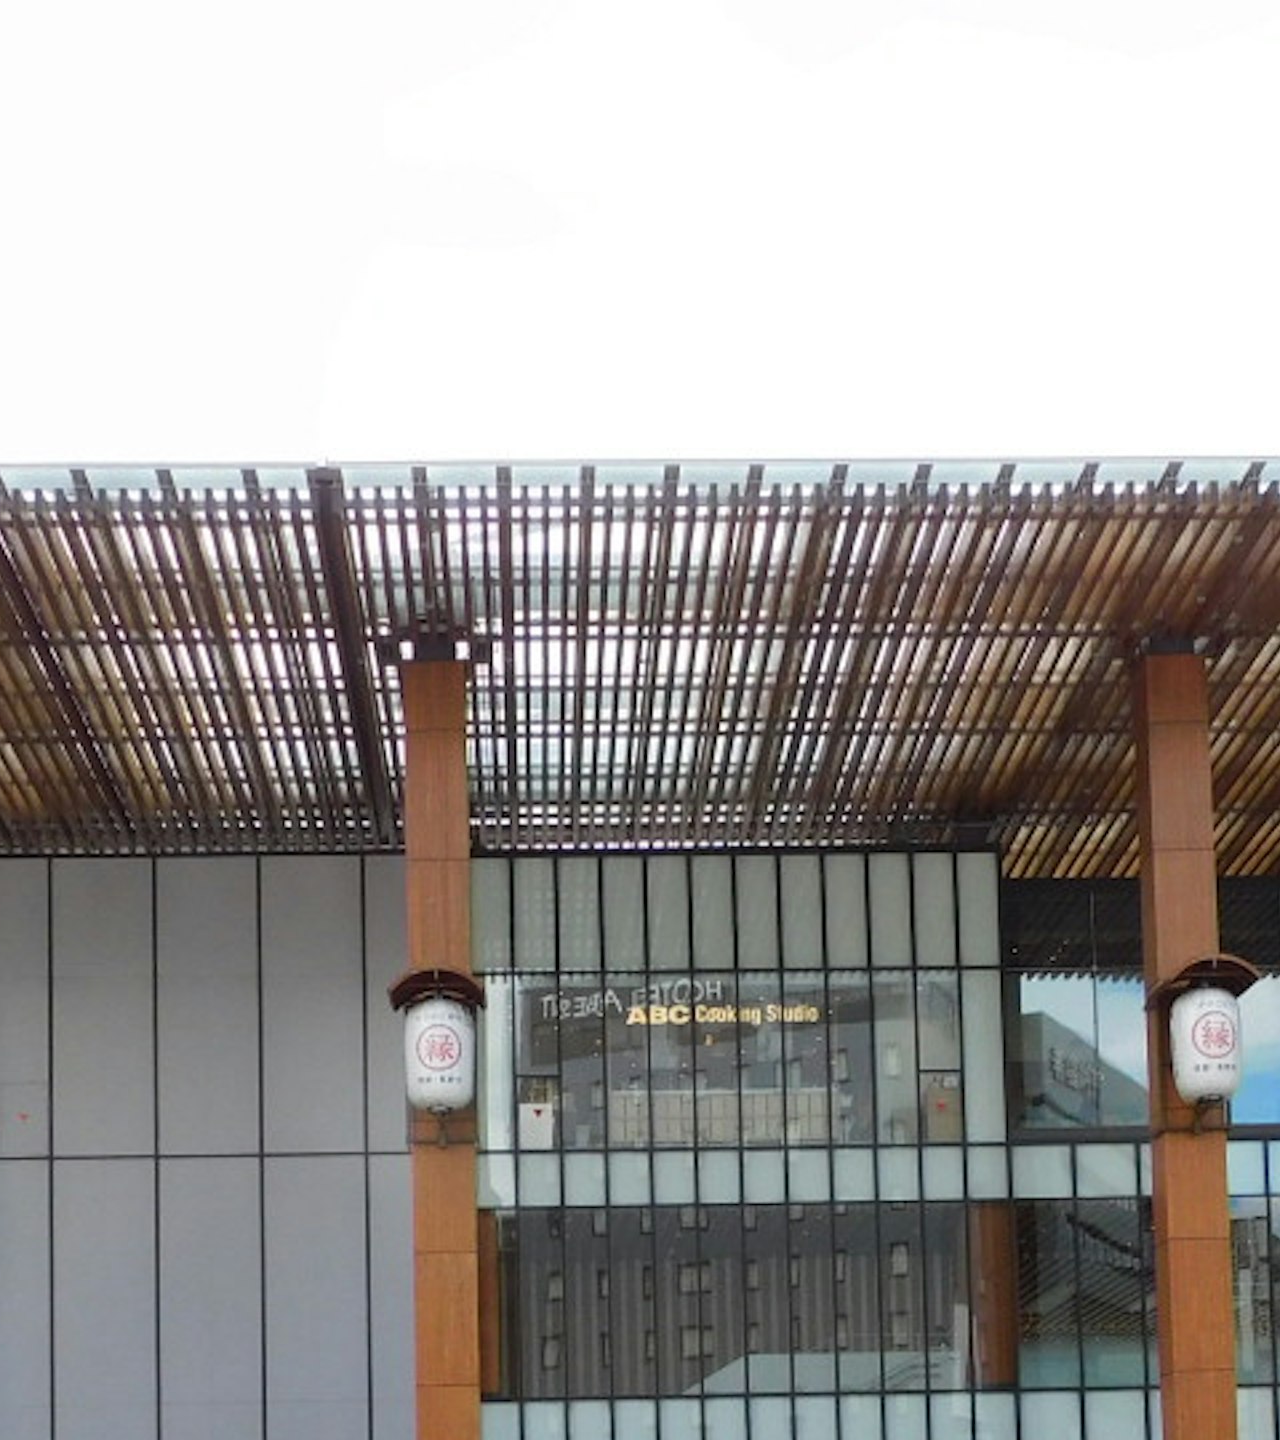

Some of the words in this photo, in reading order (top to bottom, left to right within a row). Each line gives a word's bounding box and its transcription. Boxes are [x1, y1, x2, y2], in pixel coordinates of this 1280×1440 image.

[625, 1005, 691, 1025] ABC
[695, 1004, 761, 1025] Cookng
[766, 1004, 818, 1023] Studio
